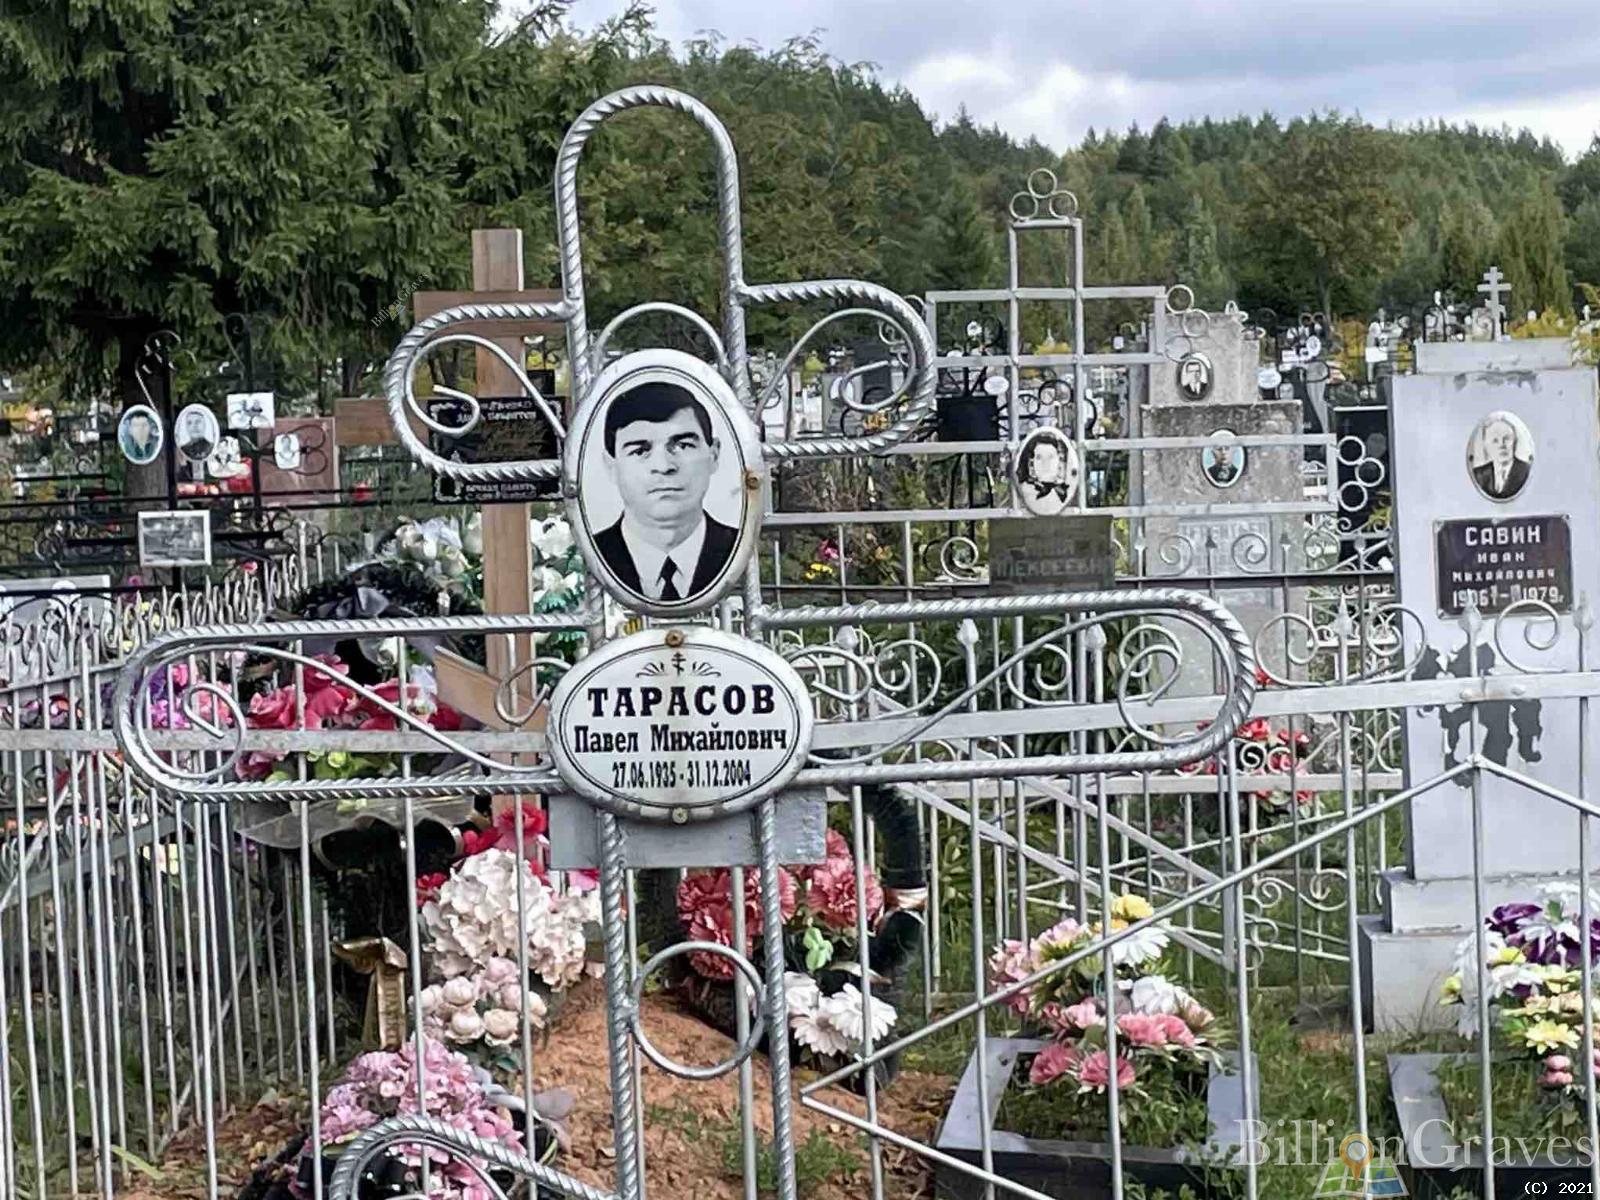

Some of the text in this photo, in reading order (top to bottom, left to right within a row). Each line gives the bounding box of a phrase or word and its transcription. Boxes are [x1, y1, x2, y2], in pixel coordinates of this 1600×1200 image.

[1465, 525, 1541, 547] САВИН
[588, 684, 776, 718] ТАРАСОВ
[574, 722, 787, 753] Павел Михайлович
[612, 760, 676, 789] 27.06.1935
[687, 759, 752, 788] 31.12.2004
